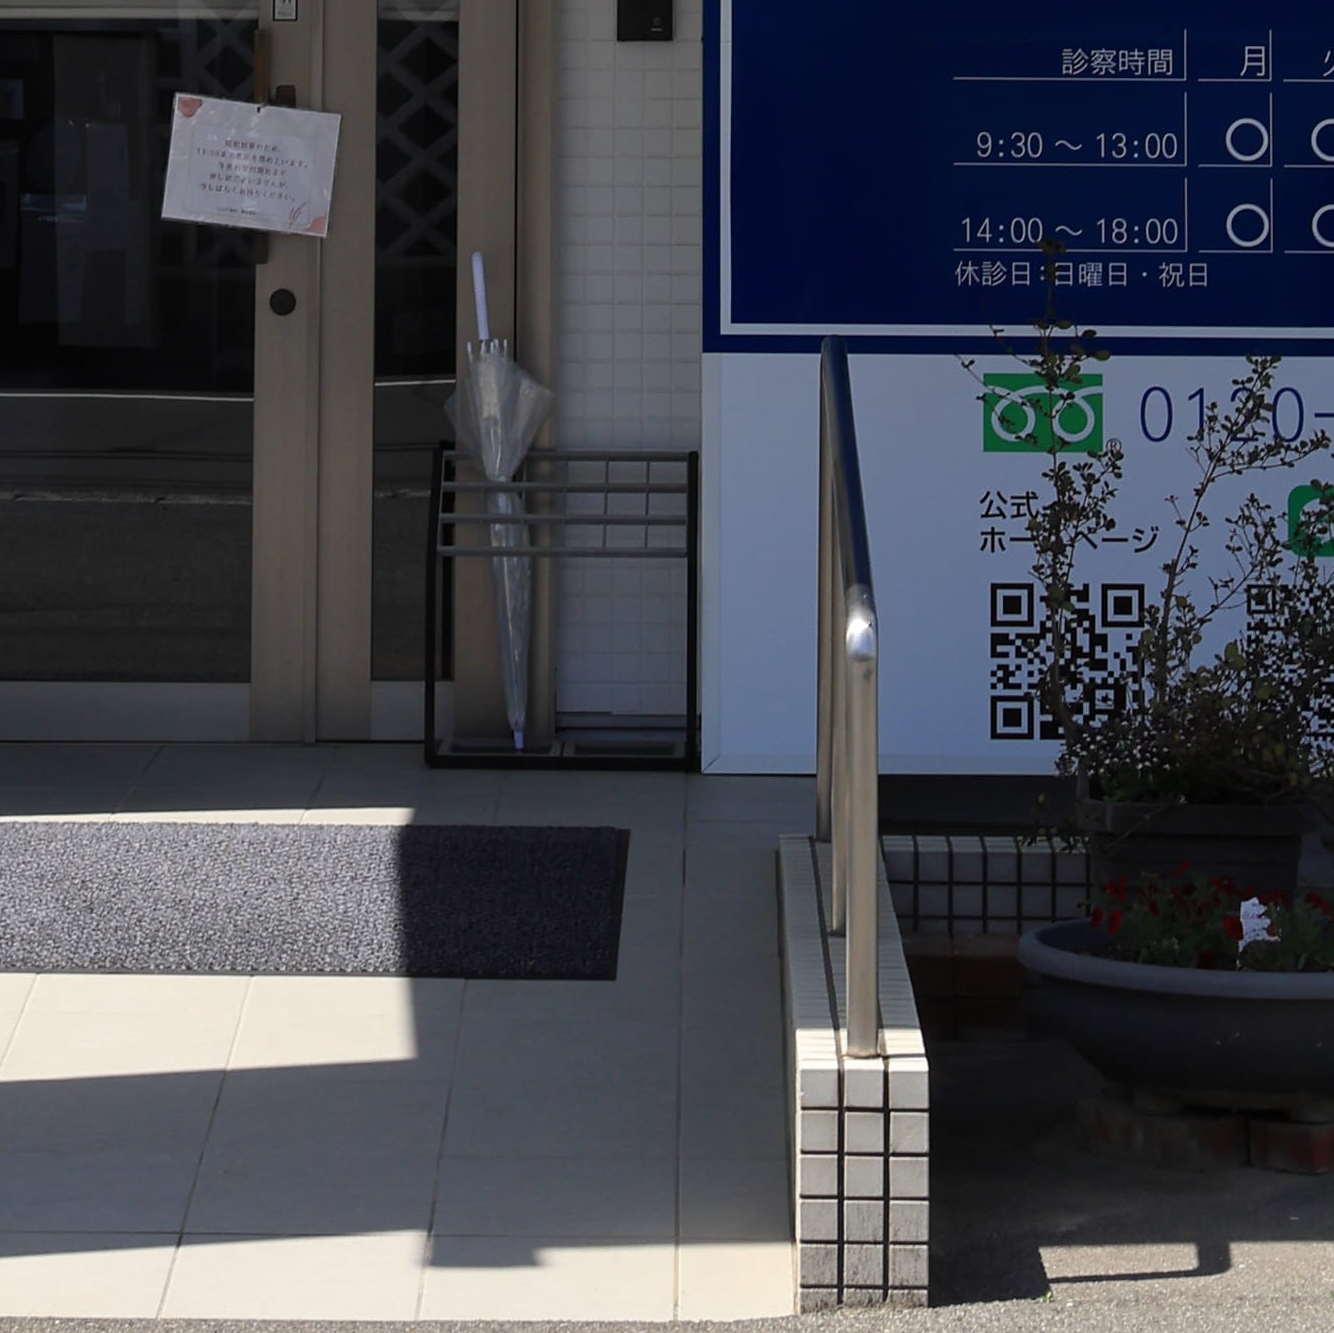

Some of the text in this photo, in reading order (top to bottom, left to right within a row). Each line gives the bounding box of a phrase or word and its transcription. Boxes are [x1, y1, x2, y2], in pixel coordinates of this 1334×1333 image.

[1062, 47, 1174, 76] 診察時間
[1240, 45, 1268, 77] 月
[976, 131, 1044, 159] 9:30
[1096, 132, 1178, 159] 13:00
[961, 217, 1044, 244] 14:00
[1096, 217, 1178, 245] 18:00
[979, 490, 1040, 520] 公式
